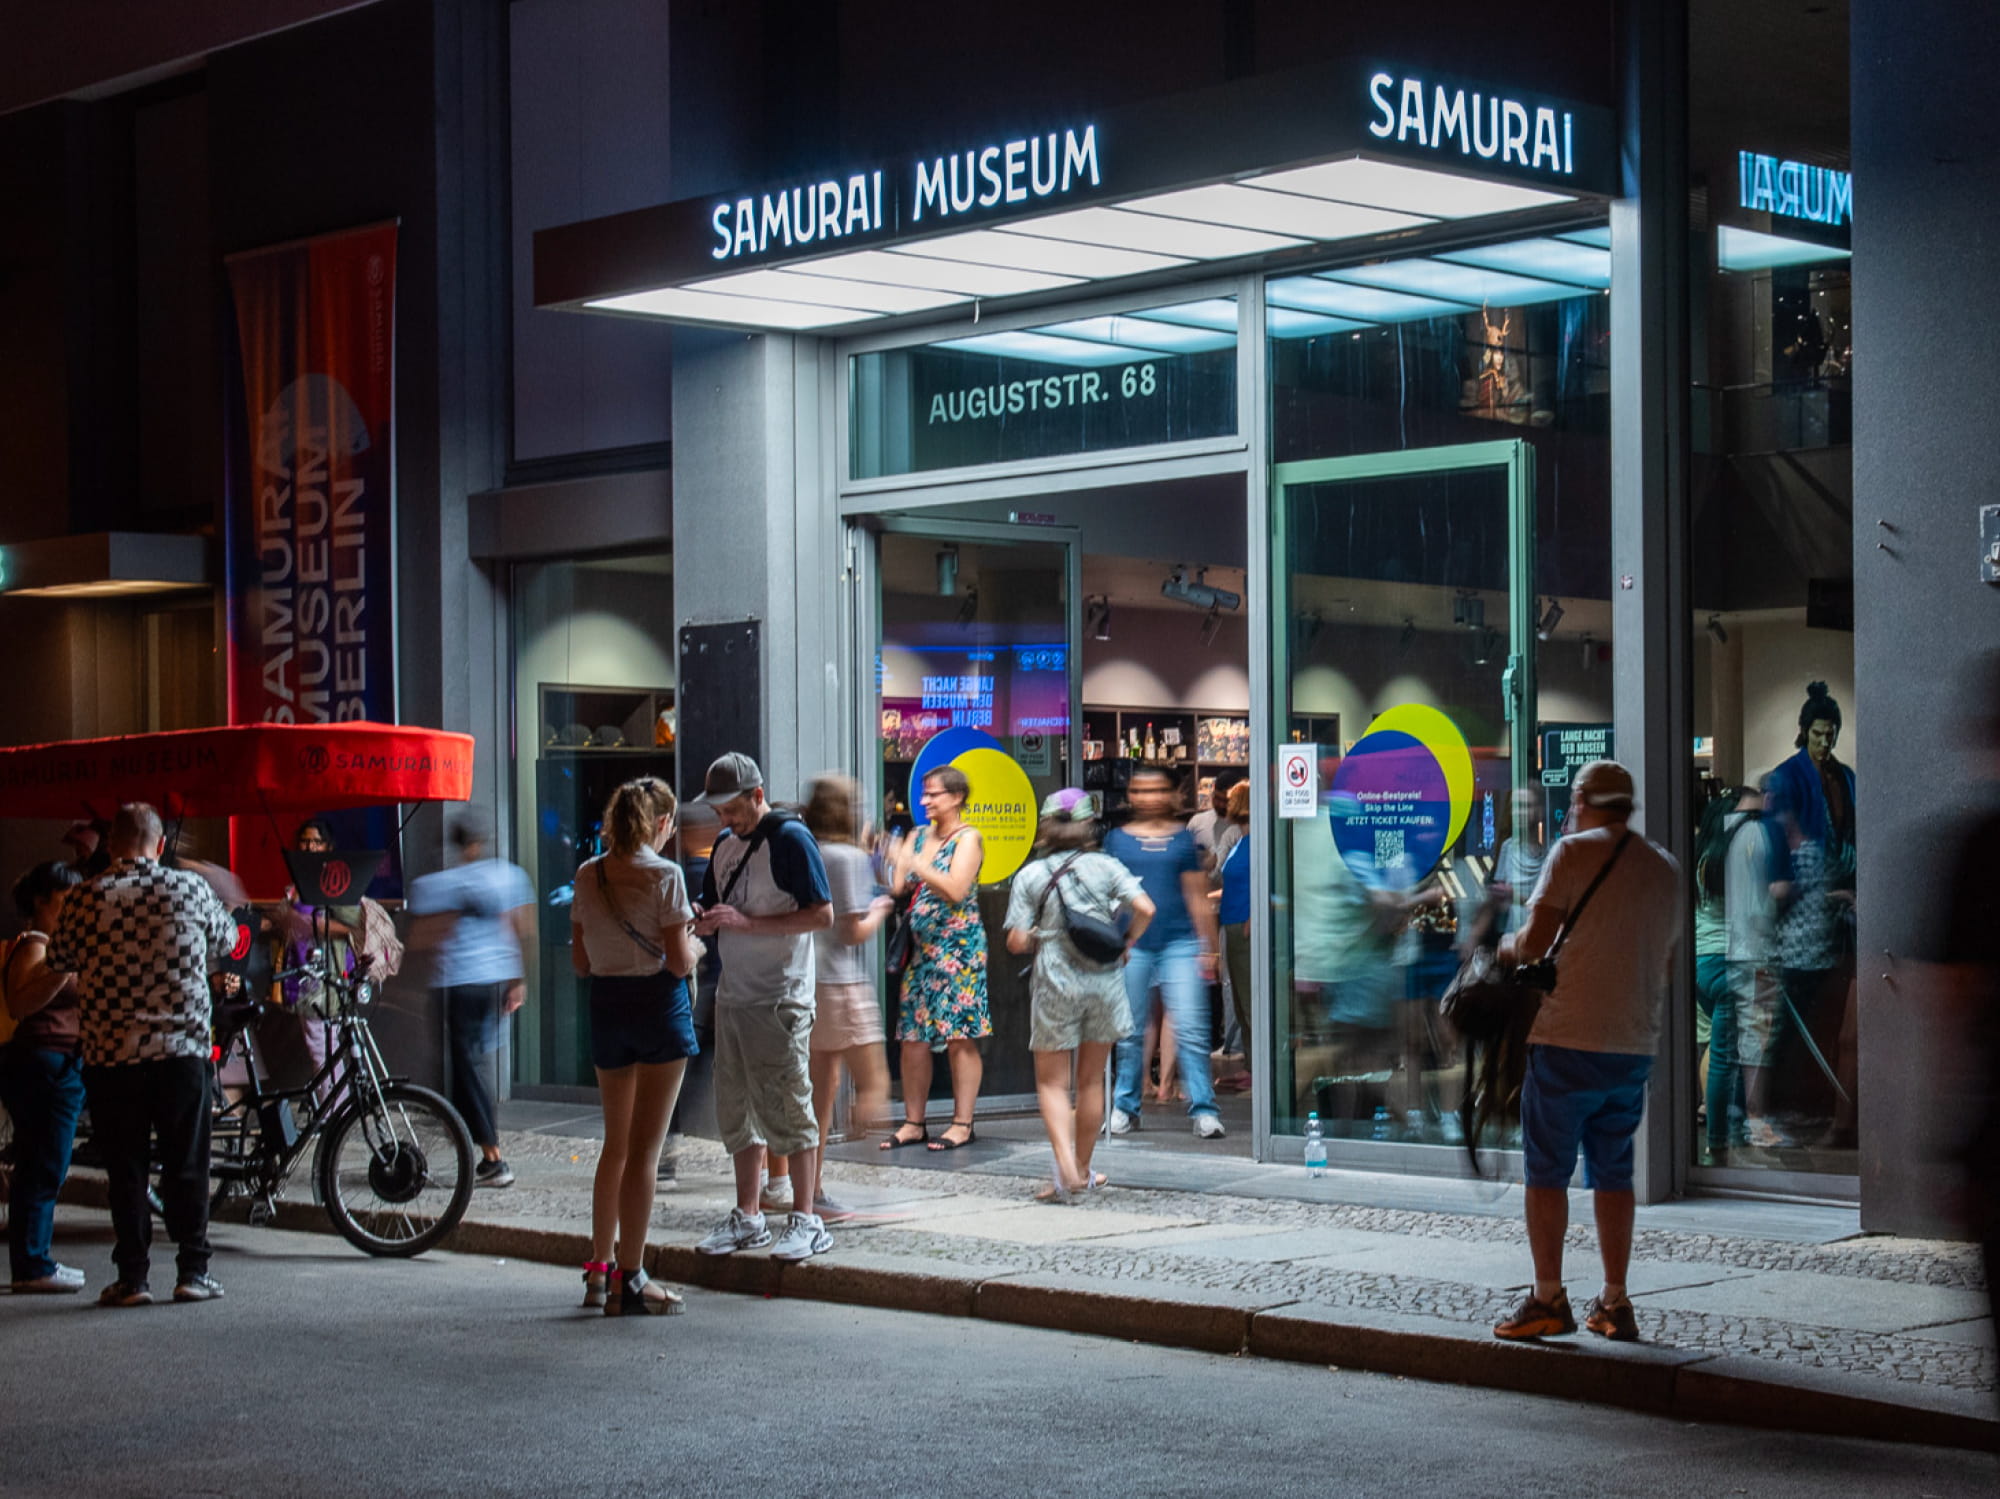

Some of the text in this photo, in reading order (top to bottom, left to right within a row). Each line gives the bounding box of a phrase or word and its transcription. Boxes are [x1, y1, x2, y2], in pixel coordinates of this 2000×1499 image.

[1369, 73, 1573, 174] SAMURAI
[712, 125, 1101, 260] SAMURAI MUSEUM
[929, 364, 1157, 425] AUGUSTSTR. 68
[336, 752, 438, 772] SAMURAI
[964, 802, 1027, 815] SAMURAI
